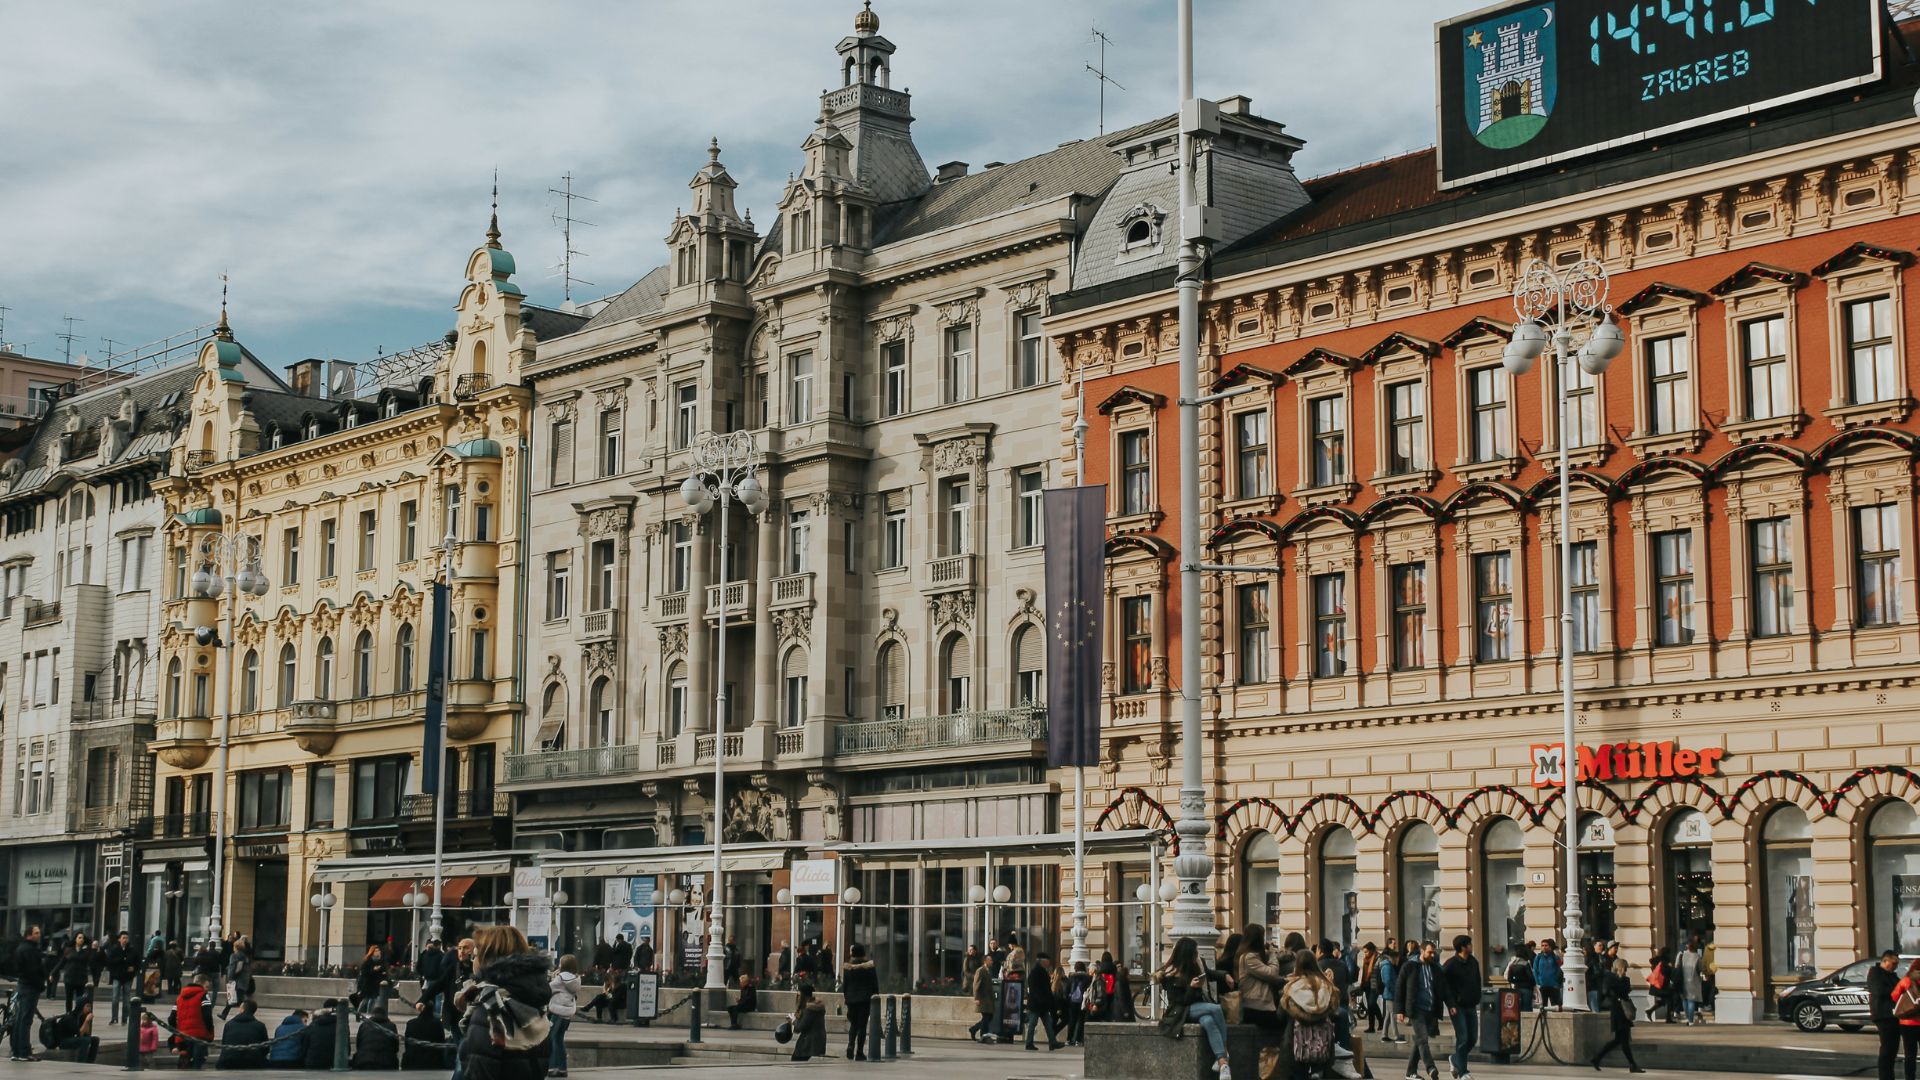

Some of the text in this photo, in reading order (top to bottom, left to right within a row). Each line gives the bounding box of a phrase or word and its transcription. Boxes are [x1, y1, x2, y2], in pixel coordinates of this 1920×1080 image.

[1641, 49, 1749, 101] ZAGREB
[1539, 756, 1558, 774] M
[1576, 741, 1724, 781] Müller
[25, 867, 68, 879] MALA KAVANA
[1828, 994, 1861, 1005] KLEMM
